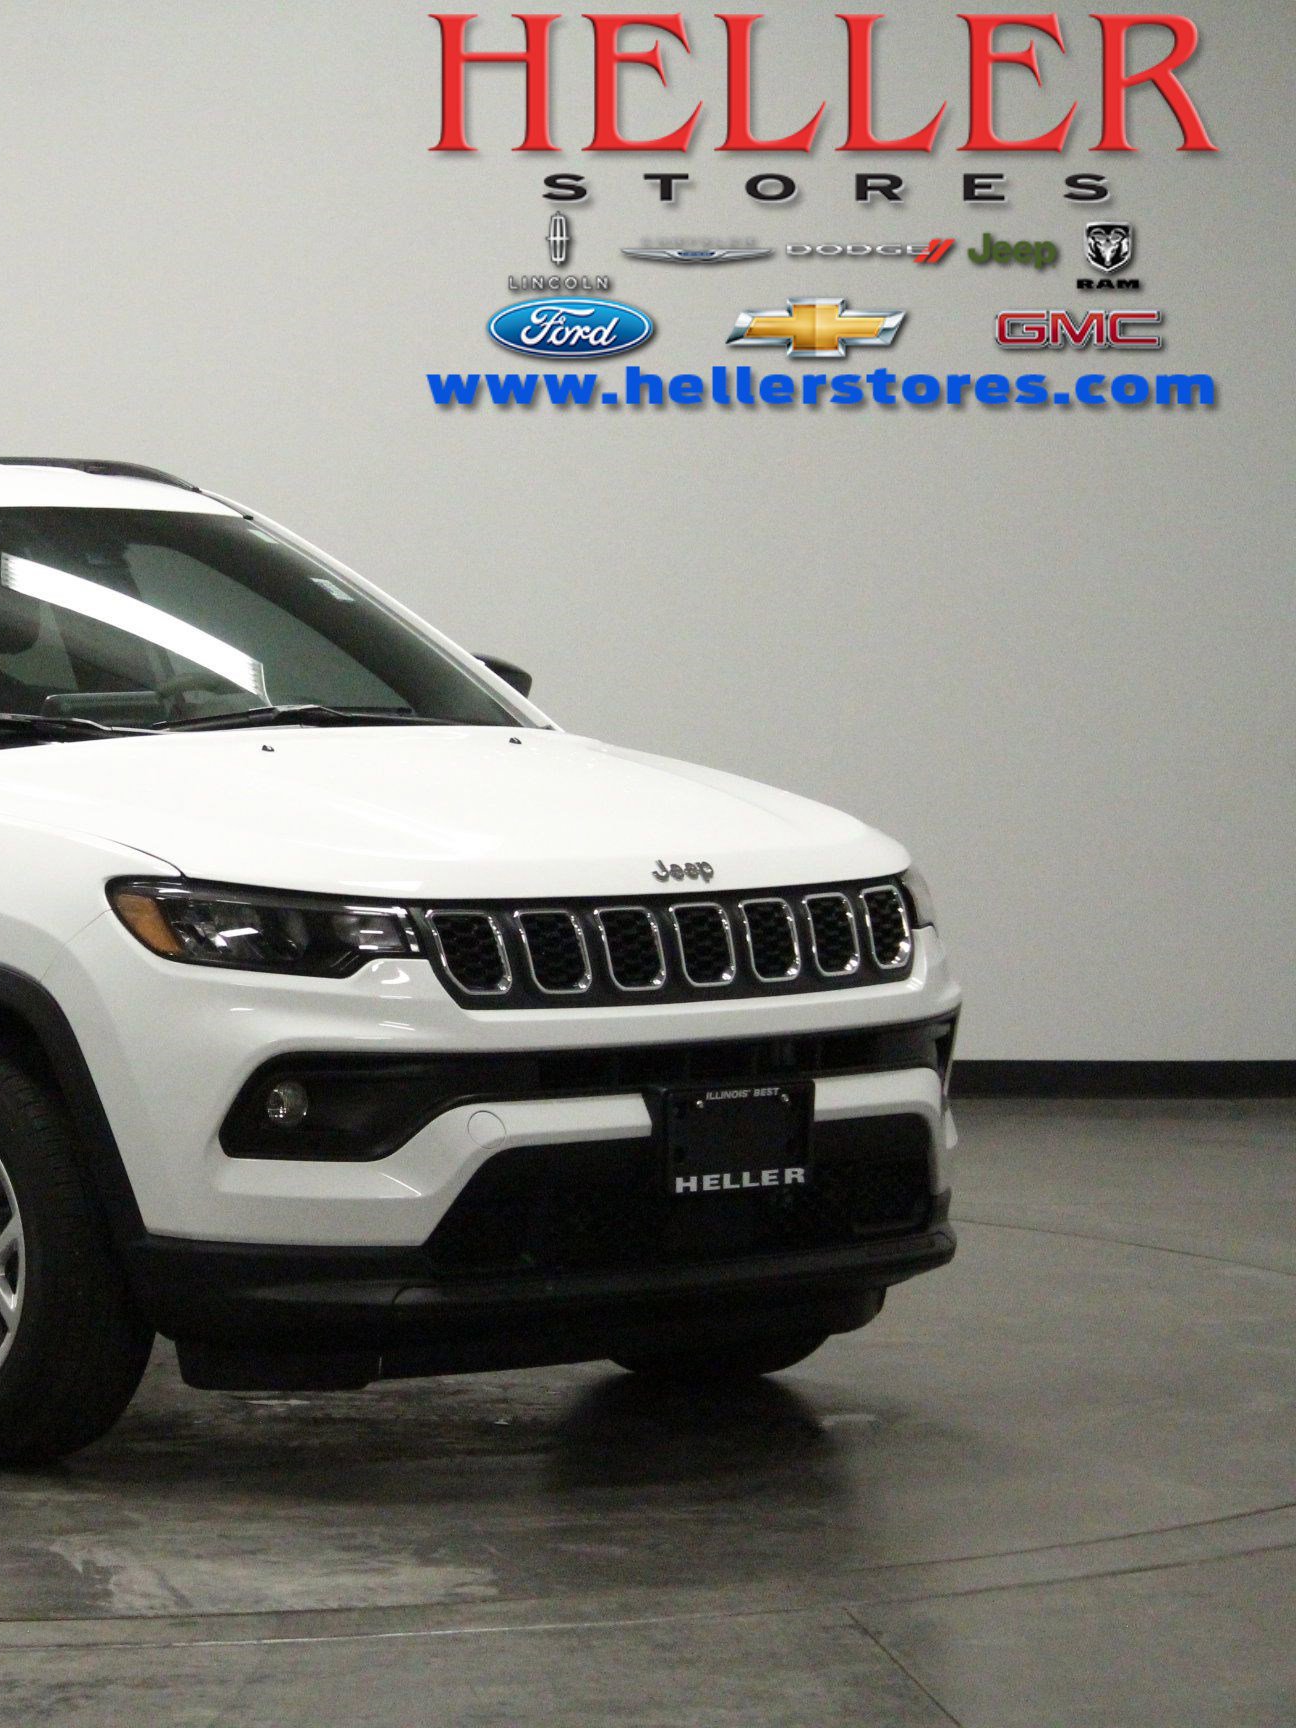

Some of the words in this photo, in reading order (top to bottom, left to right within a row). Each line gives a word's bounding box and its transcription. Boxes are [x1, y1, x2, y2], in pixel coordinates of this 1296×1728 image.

[652, 859, 714, 883] Jeep
[754, 1087, 781, 1098] BEST
[674, 1166, 806, 1194] HELLER
